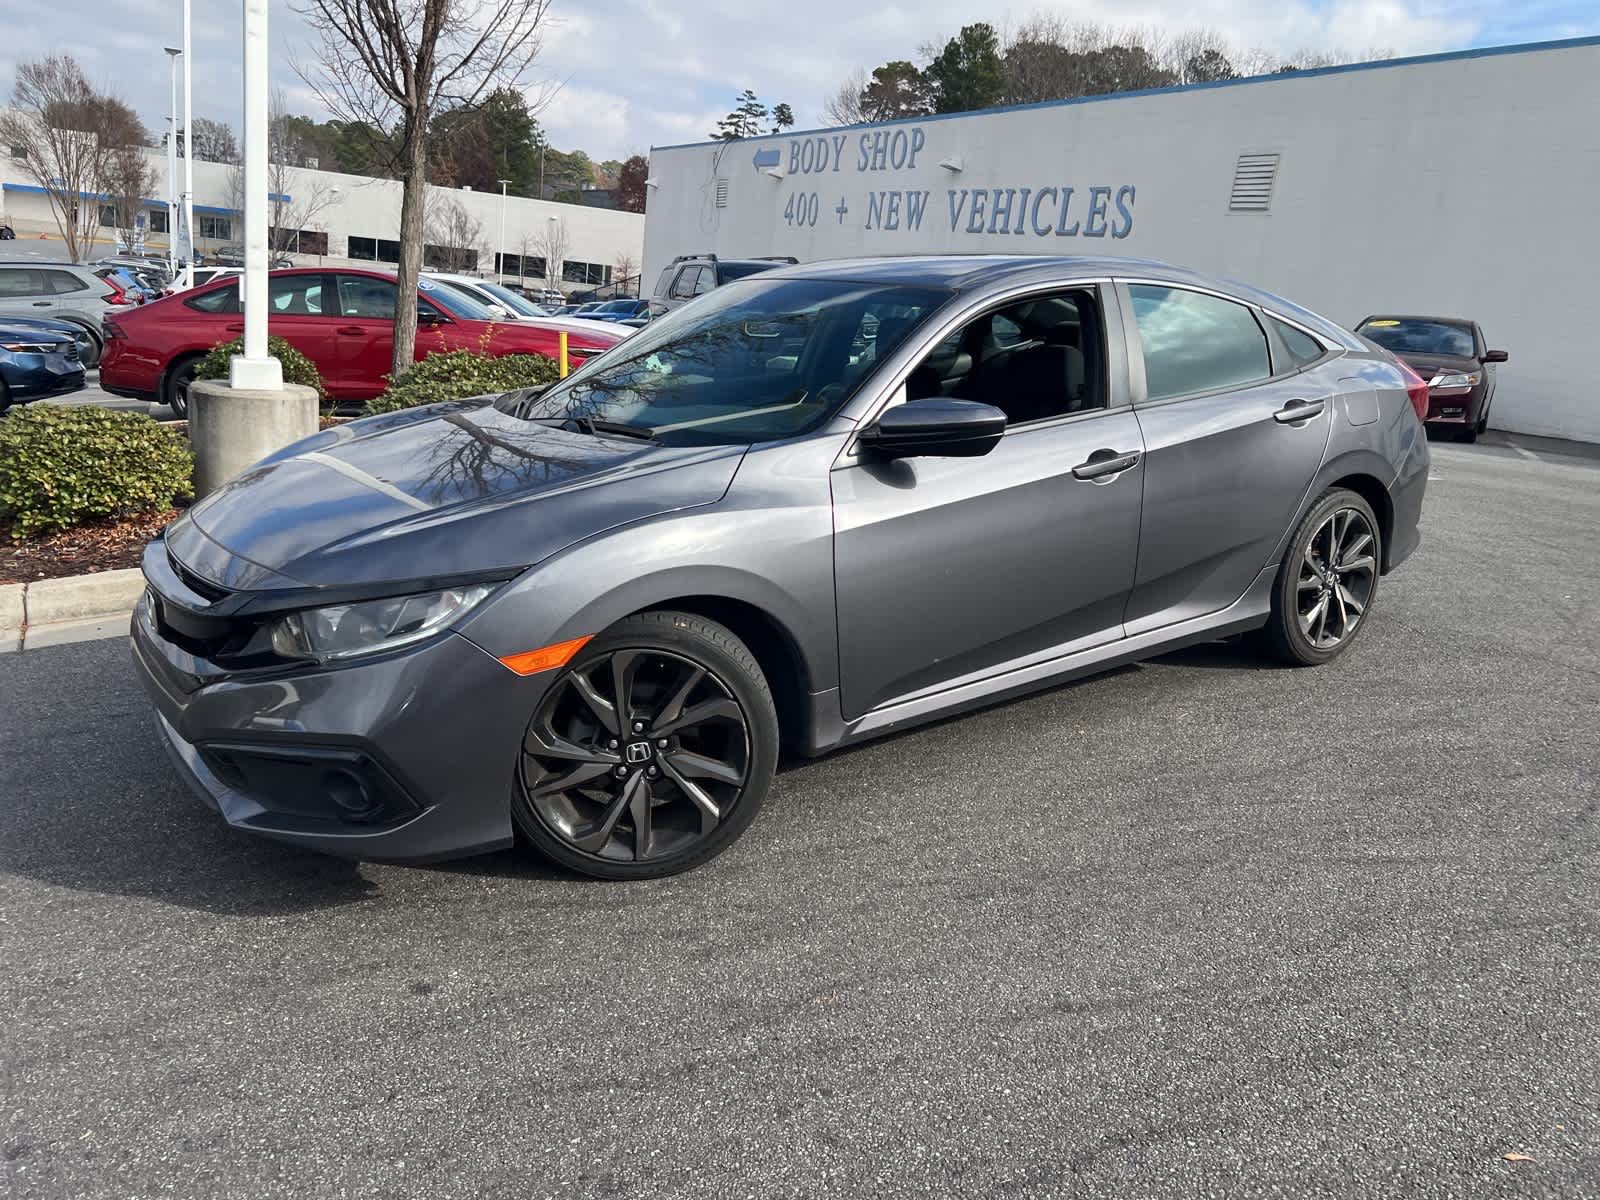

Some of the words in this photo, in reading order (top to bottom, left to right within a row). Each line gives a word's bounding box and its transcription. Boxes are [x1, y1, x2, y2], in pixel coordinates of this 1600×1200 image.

[787, 135, 847, 175] BODY
[857, 127, 925, 172] SHOP
[784, 191, 819, 227] 400
[835, 197, 848, 225] +
[865, 190, 930, 231] NEW
[948, 184, 1136, 240] VEHICLES
